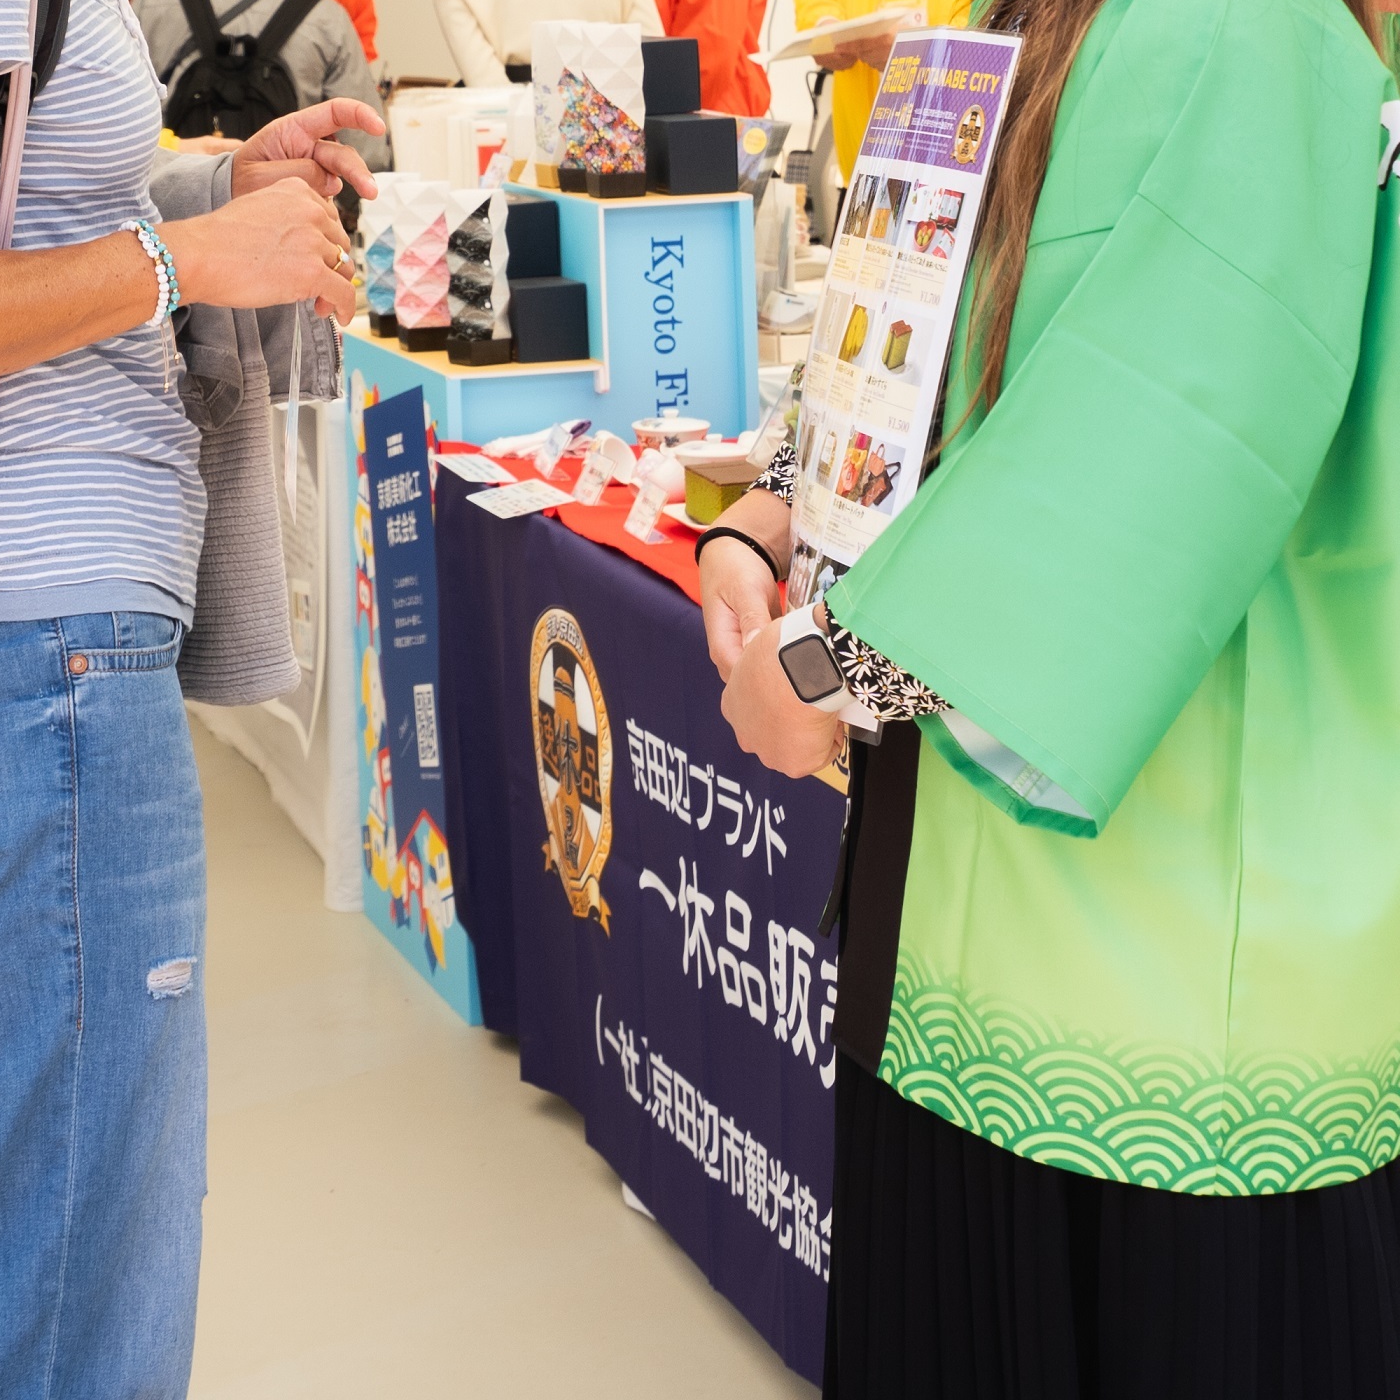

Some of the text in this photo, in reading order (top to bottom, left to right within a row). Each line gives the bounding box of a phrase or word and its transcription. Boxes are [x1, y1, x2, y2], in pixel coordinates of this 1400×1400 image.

[969, 71, 1001, 95] CITY
[644, 234, 690, 418] Kyoto Fi
[625, 717, 788, 877] 京田辺ブランド
